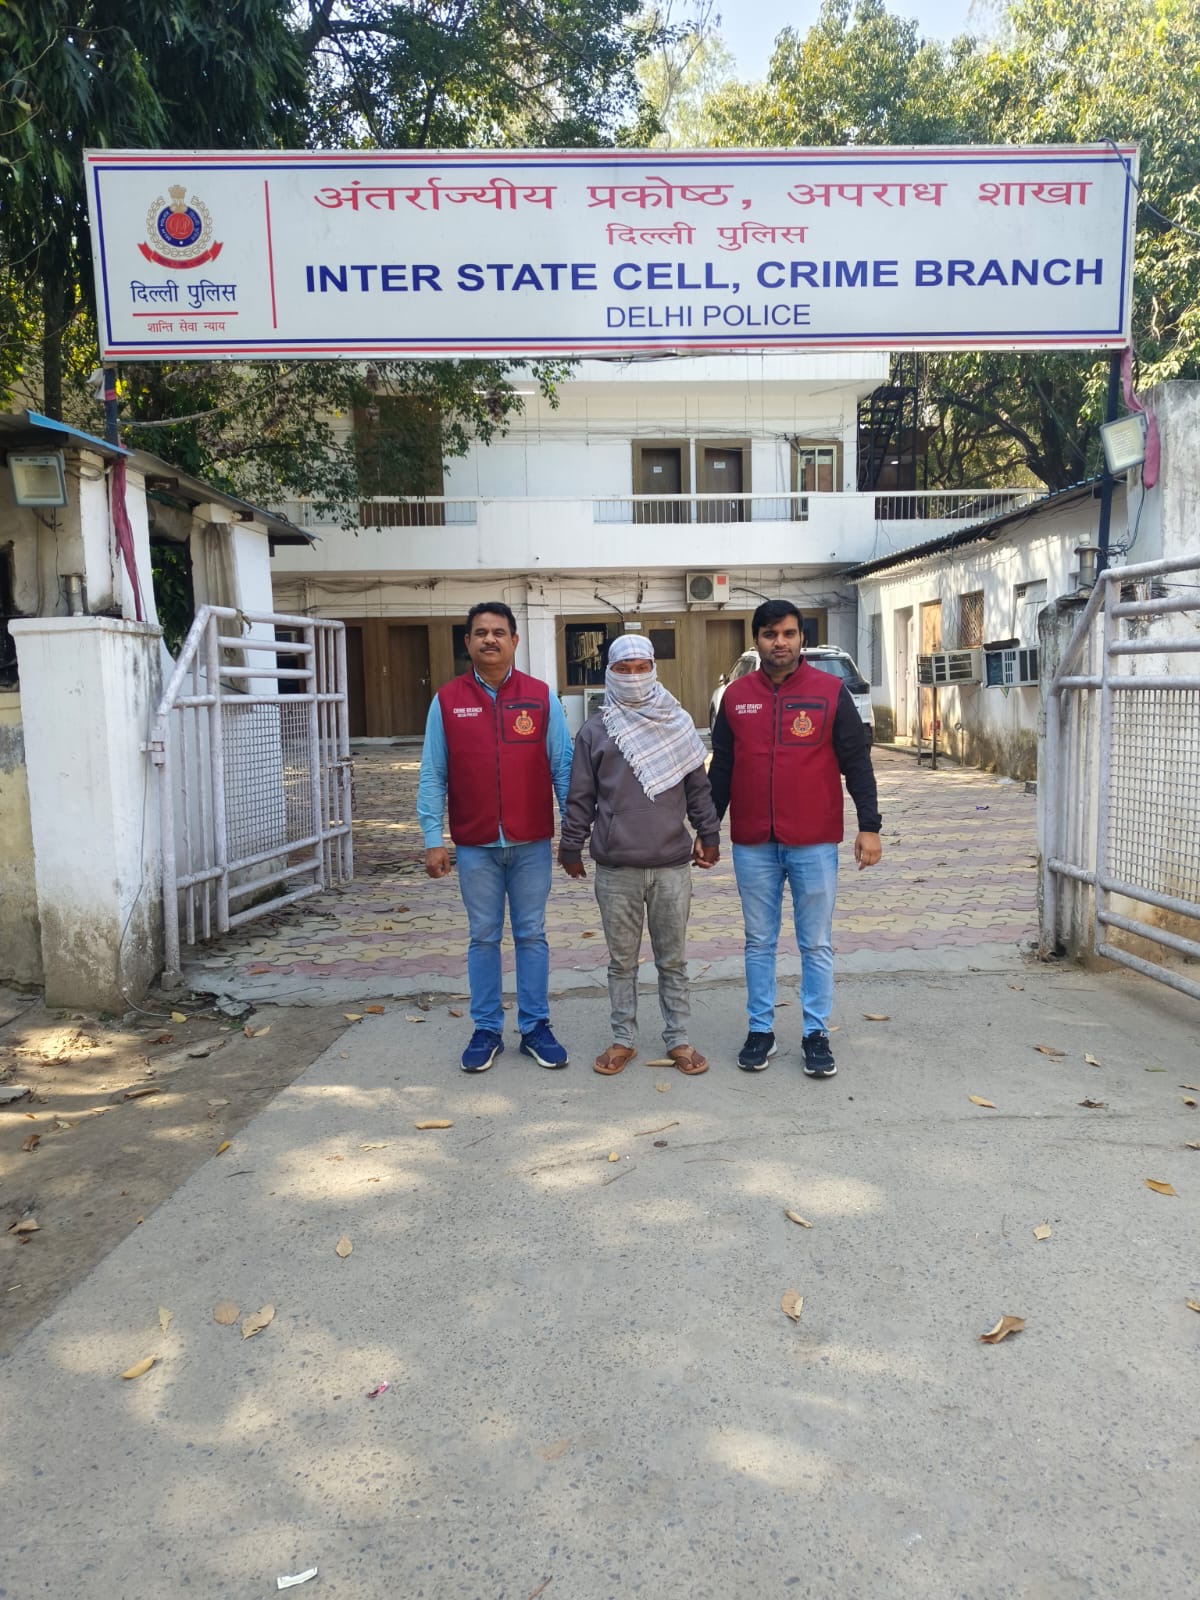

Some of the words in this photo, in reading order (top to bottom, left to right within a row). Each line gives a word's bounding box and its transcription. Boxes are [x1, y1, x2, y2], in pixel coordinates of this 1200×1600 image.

[314, 177, 557, 211] अंतर्राज्यीय
[587, 176, 752, 211] प्रकोष्ठ,
[787, 182, 948, 207] अपराध
[978, 181, 1093, 206] शाखा
[606, 222, 696, 246] दिल्ली
[716, 221, 809, 251] पुलिस
[306, 265, 443, 293] INTER
[457, 263, 598, 292] STATE
[613, 262, 740, 295] CELL,
[757, 260, 899, 289] CRIME
[914, 258, 1103, 287] BRANCH
[130, 280, 179, 303] दिल्ली
[187, 279, 237, 309] पुलिस
[147, 319, 173, 333] शान्ति
[179, 319, 198, 332] सेवा
[203, 321, 225, 332] न्याय
[606, 305, 692, 328] DELHI
[703, 303, 811, 327] POLICE
